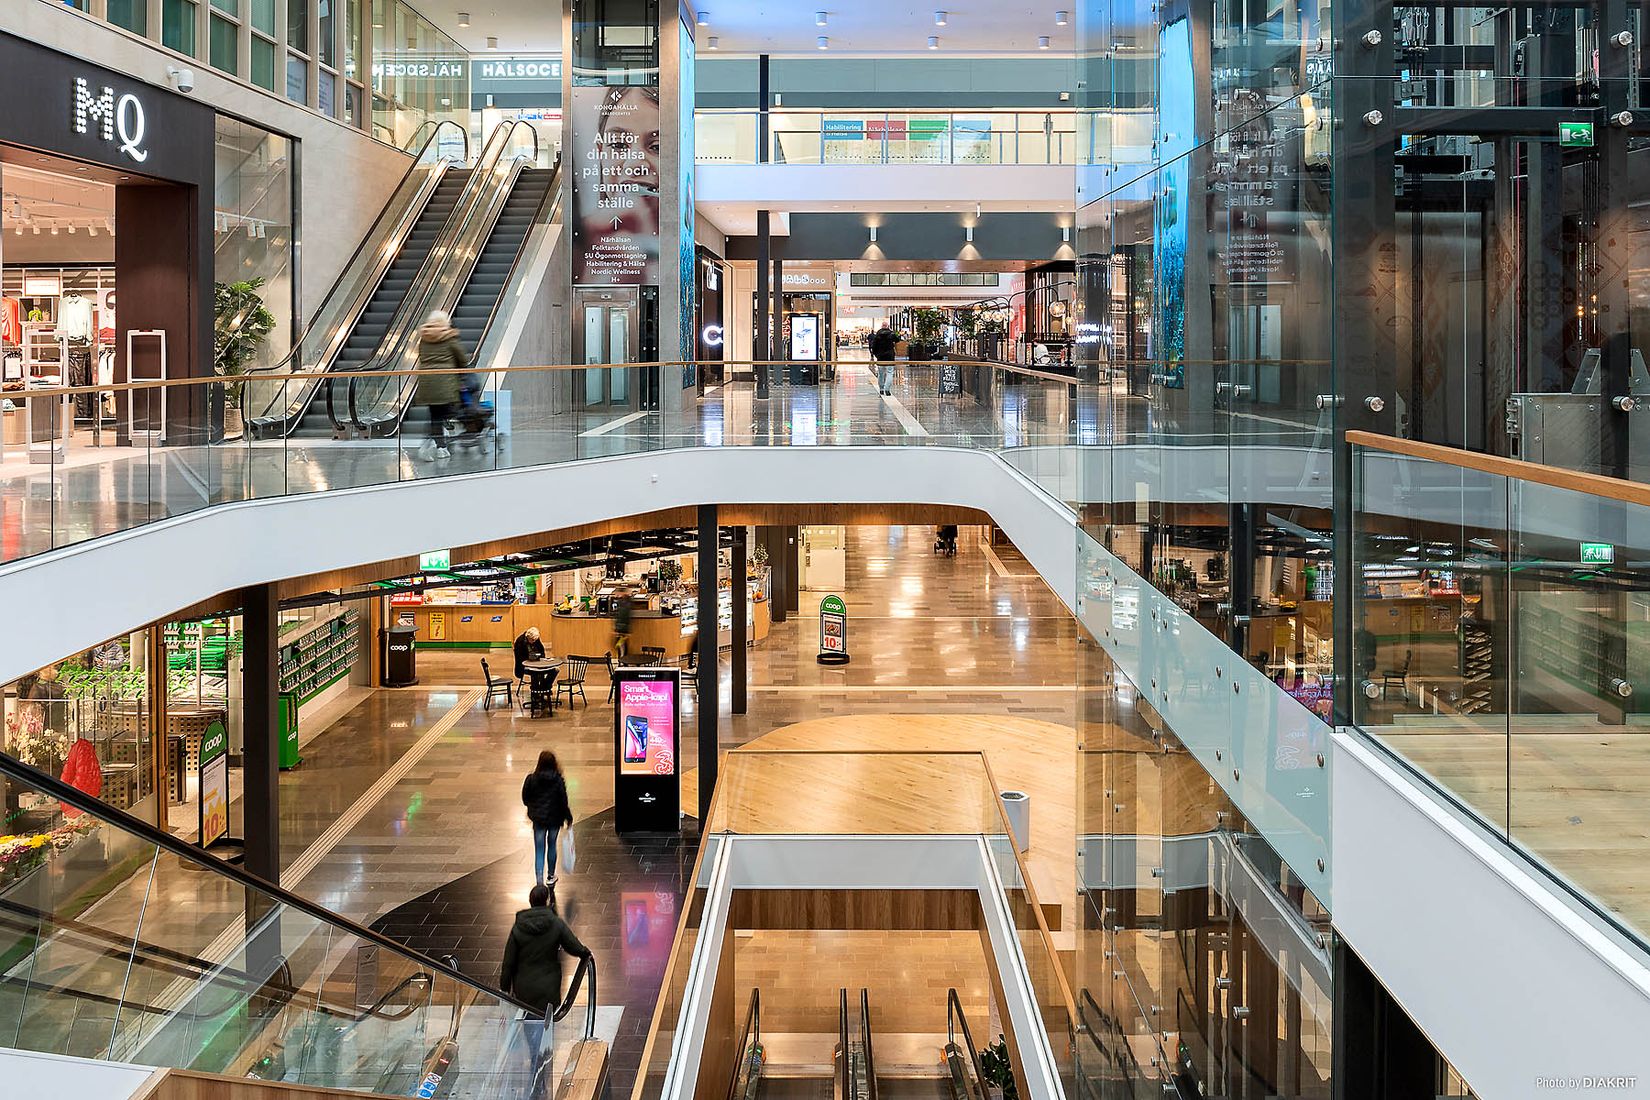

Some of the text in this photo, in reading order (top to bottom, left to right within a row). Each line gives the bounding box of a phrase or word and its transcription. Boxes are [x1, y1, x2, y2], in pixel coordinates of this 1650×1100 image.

[482, 62, 562, 77] HÄLSOCE
[74, 77, 148, 162] MQ
[593, 132, 640, 143] Allt för
[586, 148, 645, 160] din hälsa
[582, 164, 649, 178] på ett och
[592, 183, 639, 192] samma
[597, 197, 634, 208] ställe
[390, 644, 408, 652] coop
[624, 684, 649, 693] Smart
[204, 733, 223, 752] coop
